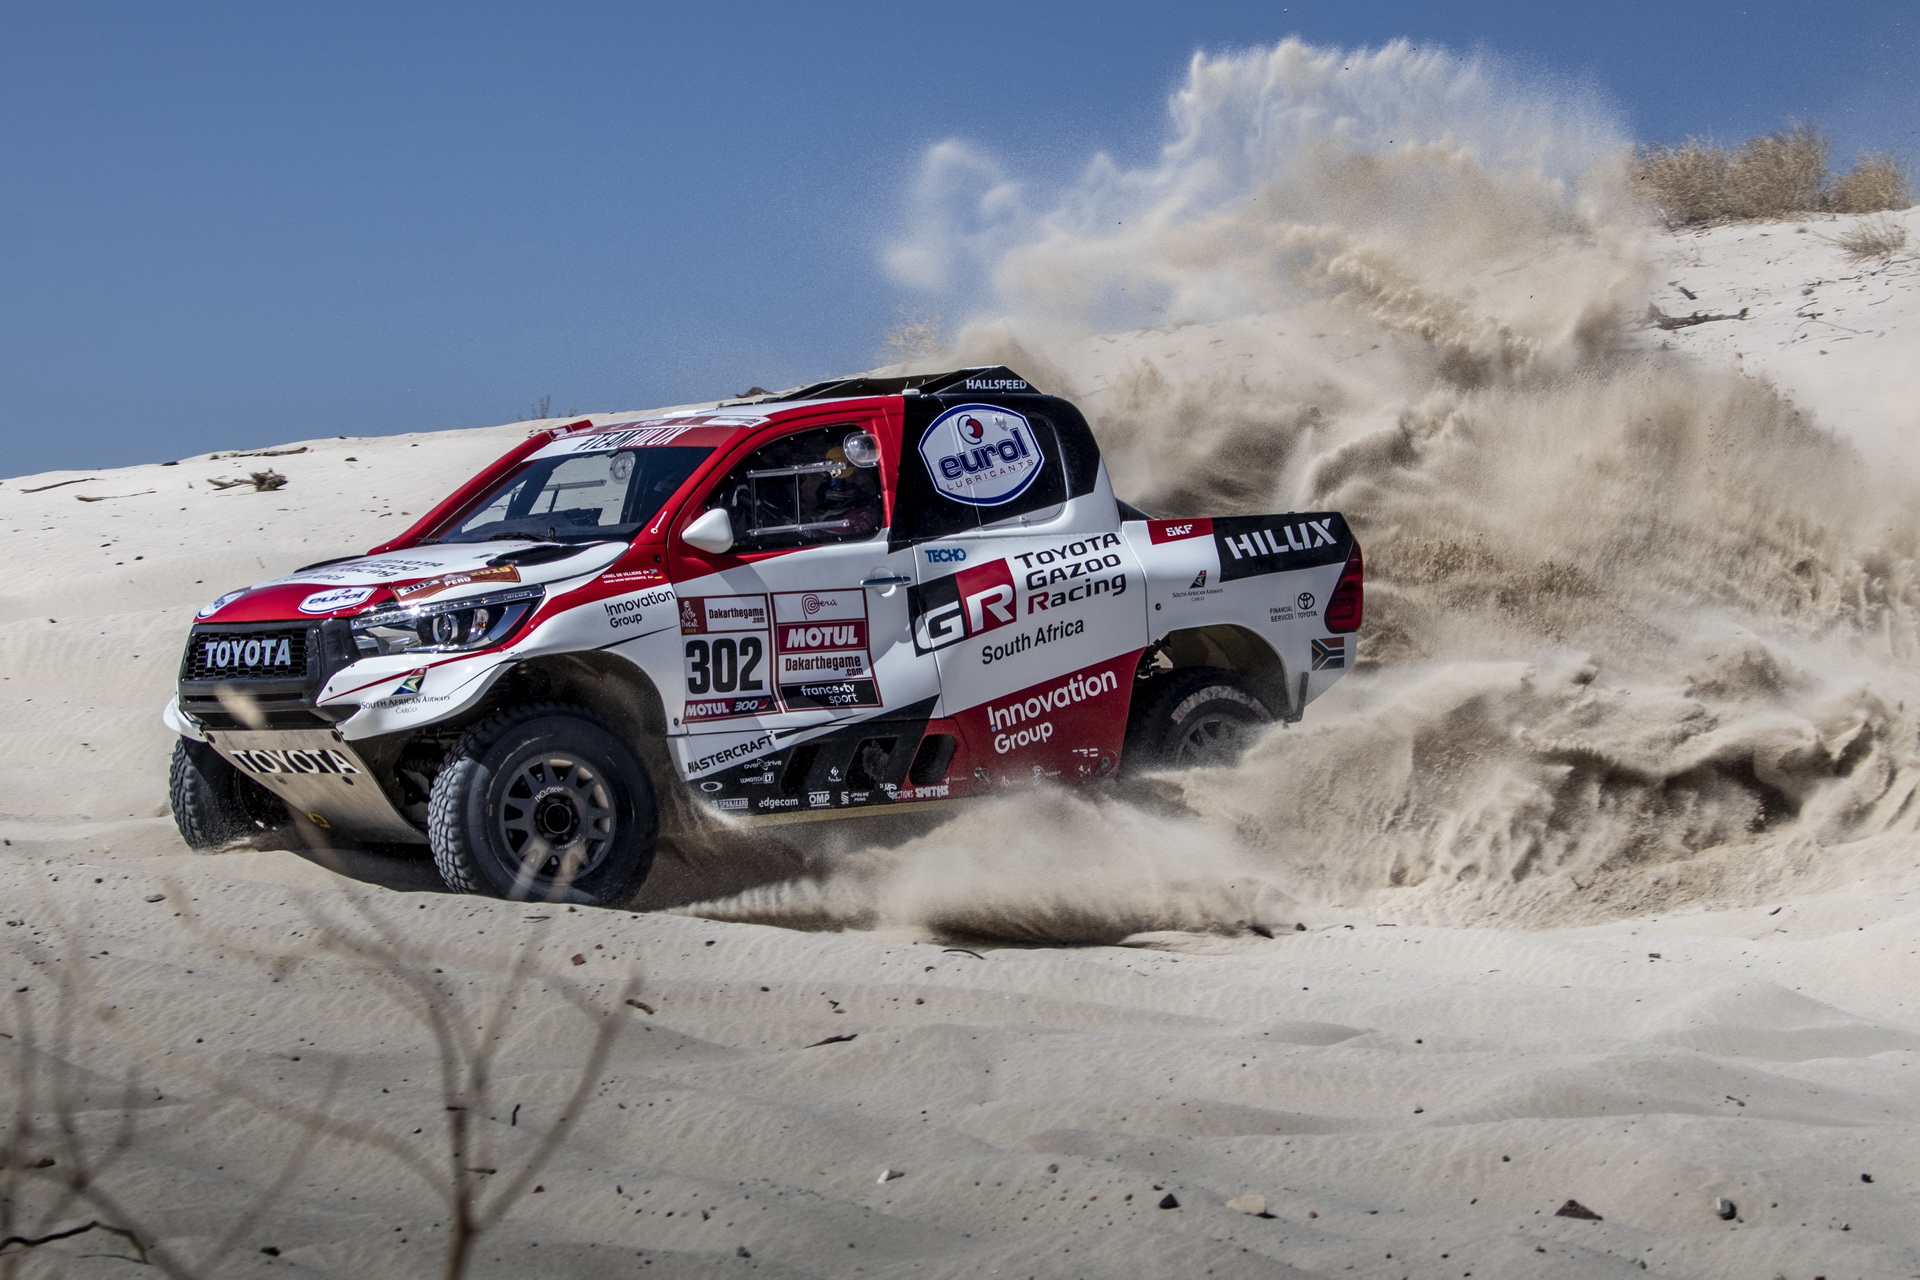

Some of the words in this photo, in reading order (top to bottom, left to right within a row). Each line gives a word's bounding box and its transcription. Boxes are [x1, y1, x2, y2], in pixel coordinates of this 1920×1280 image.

[966, 379, 1027, 390] HALLSPEED
[938, 427, 1030, 481] eurol
[946, 459, 1034, 490] LUBRICANTS
[1165, 524, 1193, 537] SKF
[1224, 517, 1337, 560] HILUX
[1014, 532, 1121, 569] TOYOTA
[470, 567, 511, 577] 2019
[1025, 553, 1121, 591] GAZOO
[405, 581, 432, 593] 302
[1027, 573, 1127, 615] Racing
[308, 590, 366, 605] eurol
[604, 590, 675, 616] Innovation
[708, 608, 764, 619] Dakarthegame
[915, 583, 1014, 651] GR
[1269, 606, 1293, 615] FINANCIAL
[1270, 613, 1294, 623] SERVICES
[1297, 611, 1318, 619] TOYOTA
[610, 613, 642, 628] Group
[786, 625, 859, 648] MOTUL
[982, 632, 1031, 665] South
[1034, 619, 1084, 647] Africa
[205, 638, 291, 668] TOYOTA
[686, 637, 763, 694] 302
[785, 655, 862, 672] Dakarthegame
[845, 667, 864, 677] .com
[361, 701, 387, 709] SOUTH
[389, 698, 421, 707] AFRICAN
[422, 695, 451, 703] AIRWAYS
[829, 693, 858, 706] sport
[987, 670, 1118, 732] Innovation
[396, 706, 417, 714] CARGO
[686, 702, 729, 717] MOTUL
[994, 721, 1053, 754] Group
[229, 749, 362, 774] TOYOTA
[808, 793, 830, 804] OMP
[915, 785, 949, 798] SMITHS
[758, 797, 799, 809] edgecam
